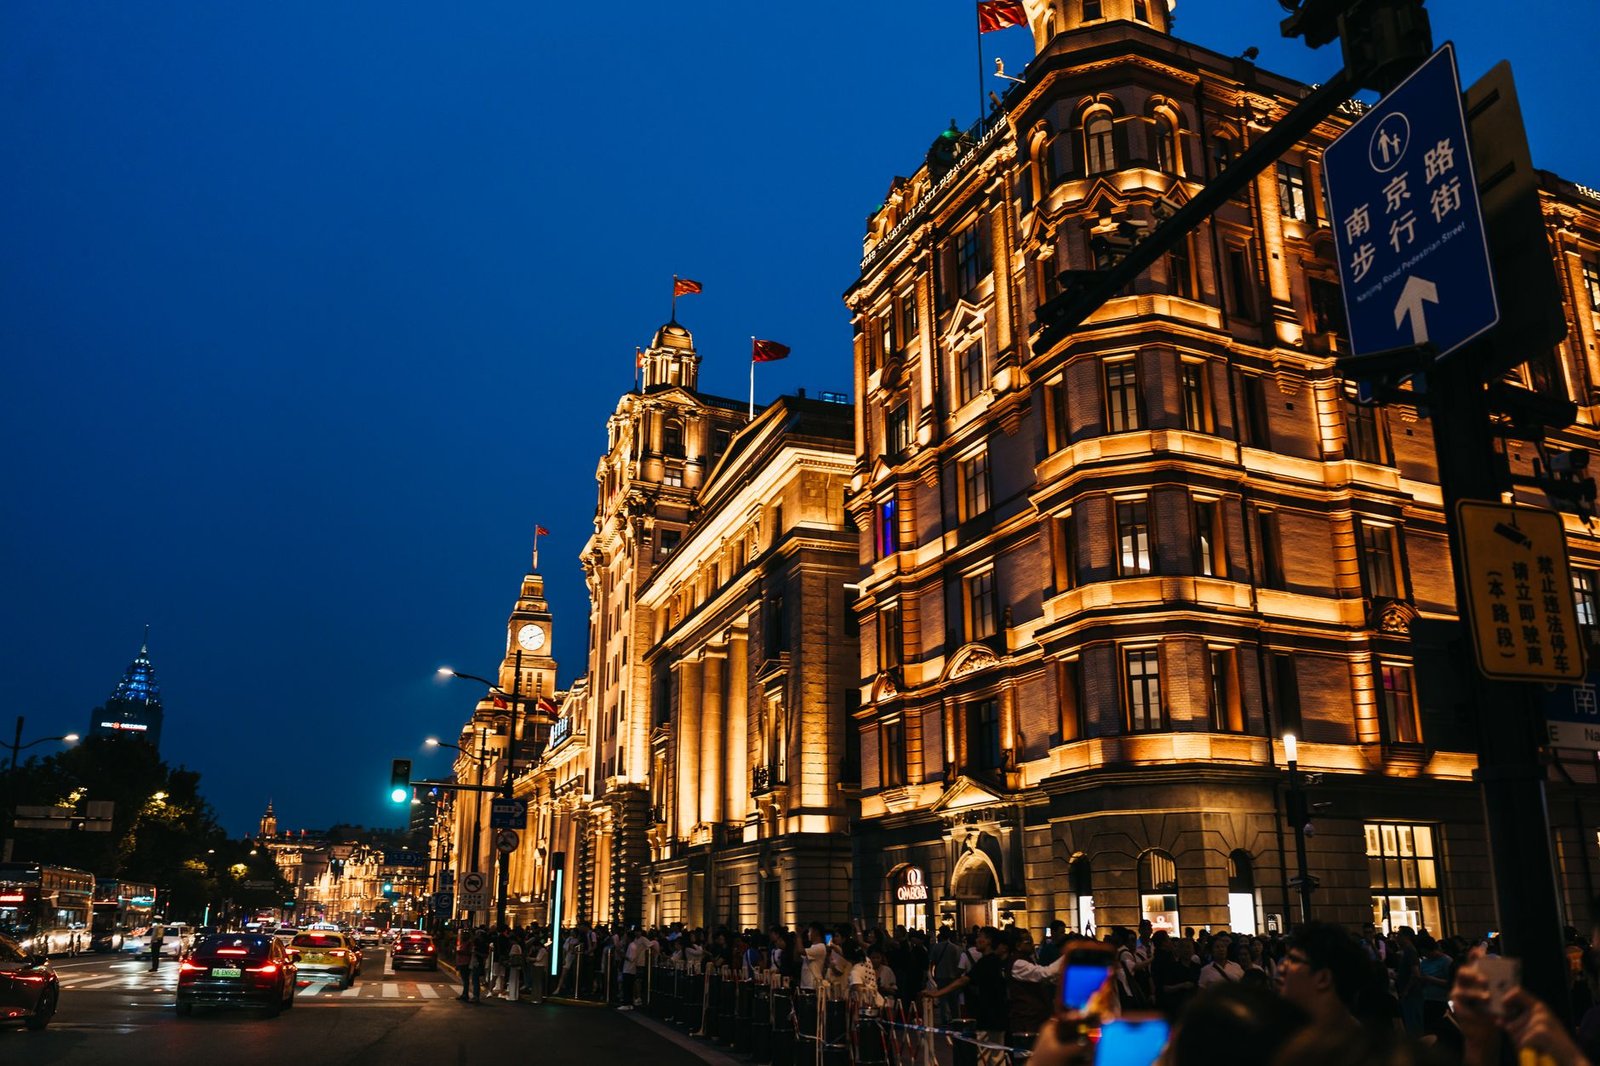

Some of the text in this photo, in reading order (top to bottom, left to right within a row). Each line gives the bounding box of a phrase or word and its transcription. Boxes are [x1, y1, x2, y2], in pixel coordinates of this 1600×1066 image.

[977, 112, 1009, 149] HOTE
[1344, 138, 1455, 245] 南京路
[1350, 176, 1461, 283] 步行街
[1382, 266, 1401, 284] Road
[1401, 239, 1441, 271] Pedestrian
[1441, 220, 1466, 243] Street
[1512, 561, 1544, 666] 请立即驶离
[1537, 555, 1570, 674] 禁止违法停车
[1549, 725, 1559, 742] E
[897, 886, 928, 900] OMEGA
